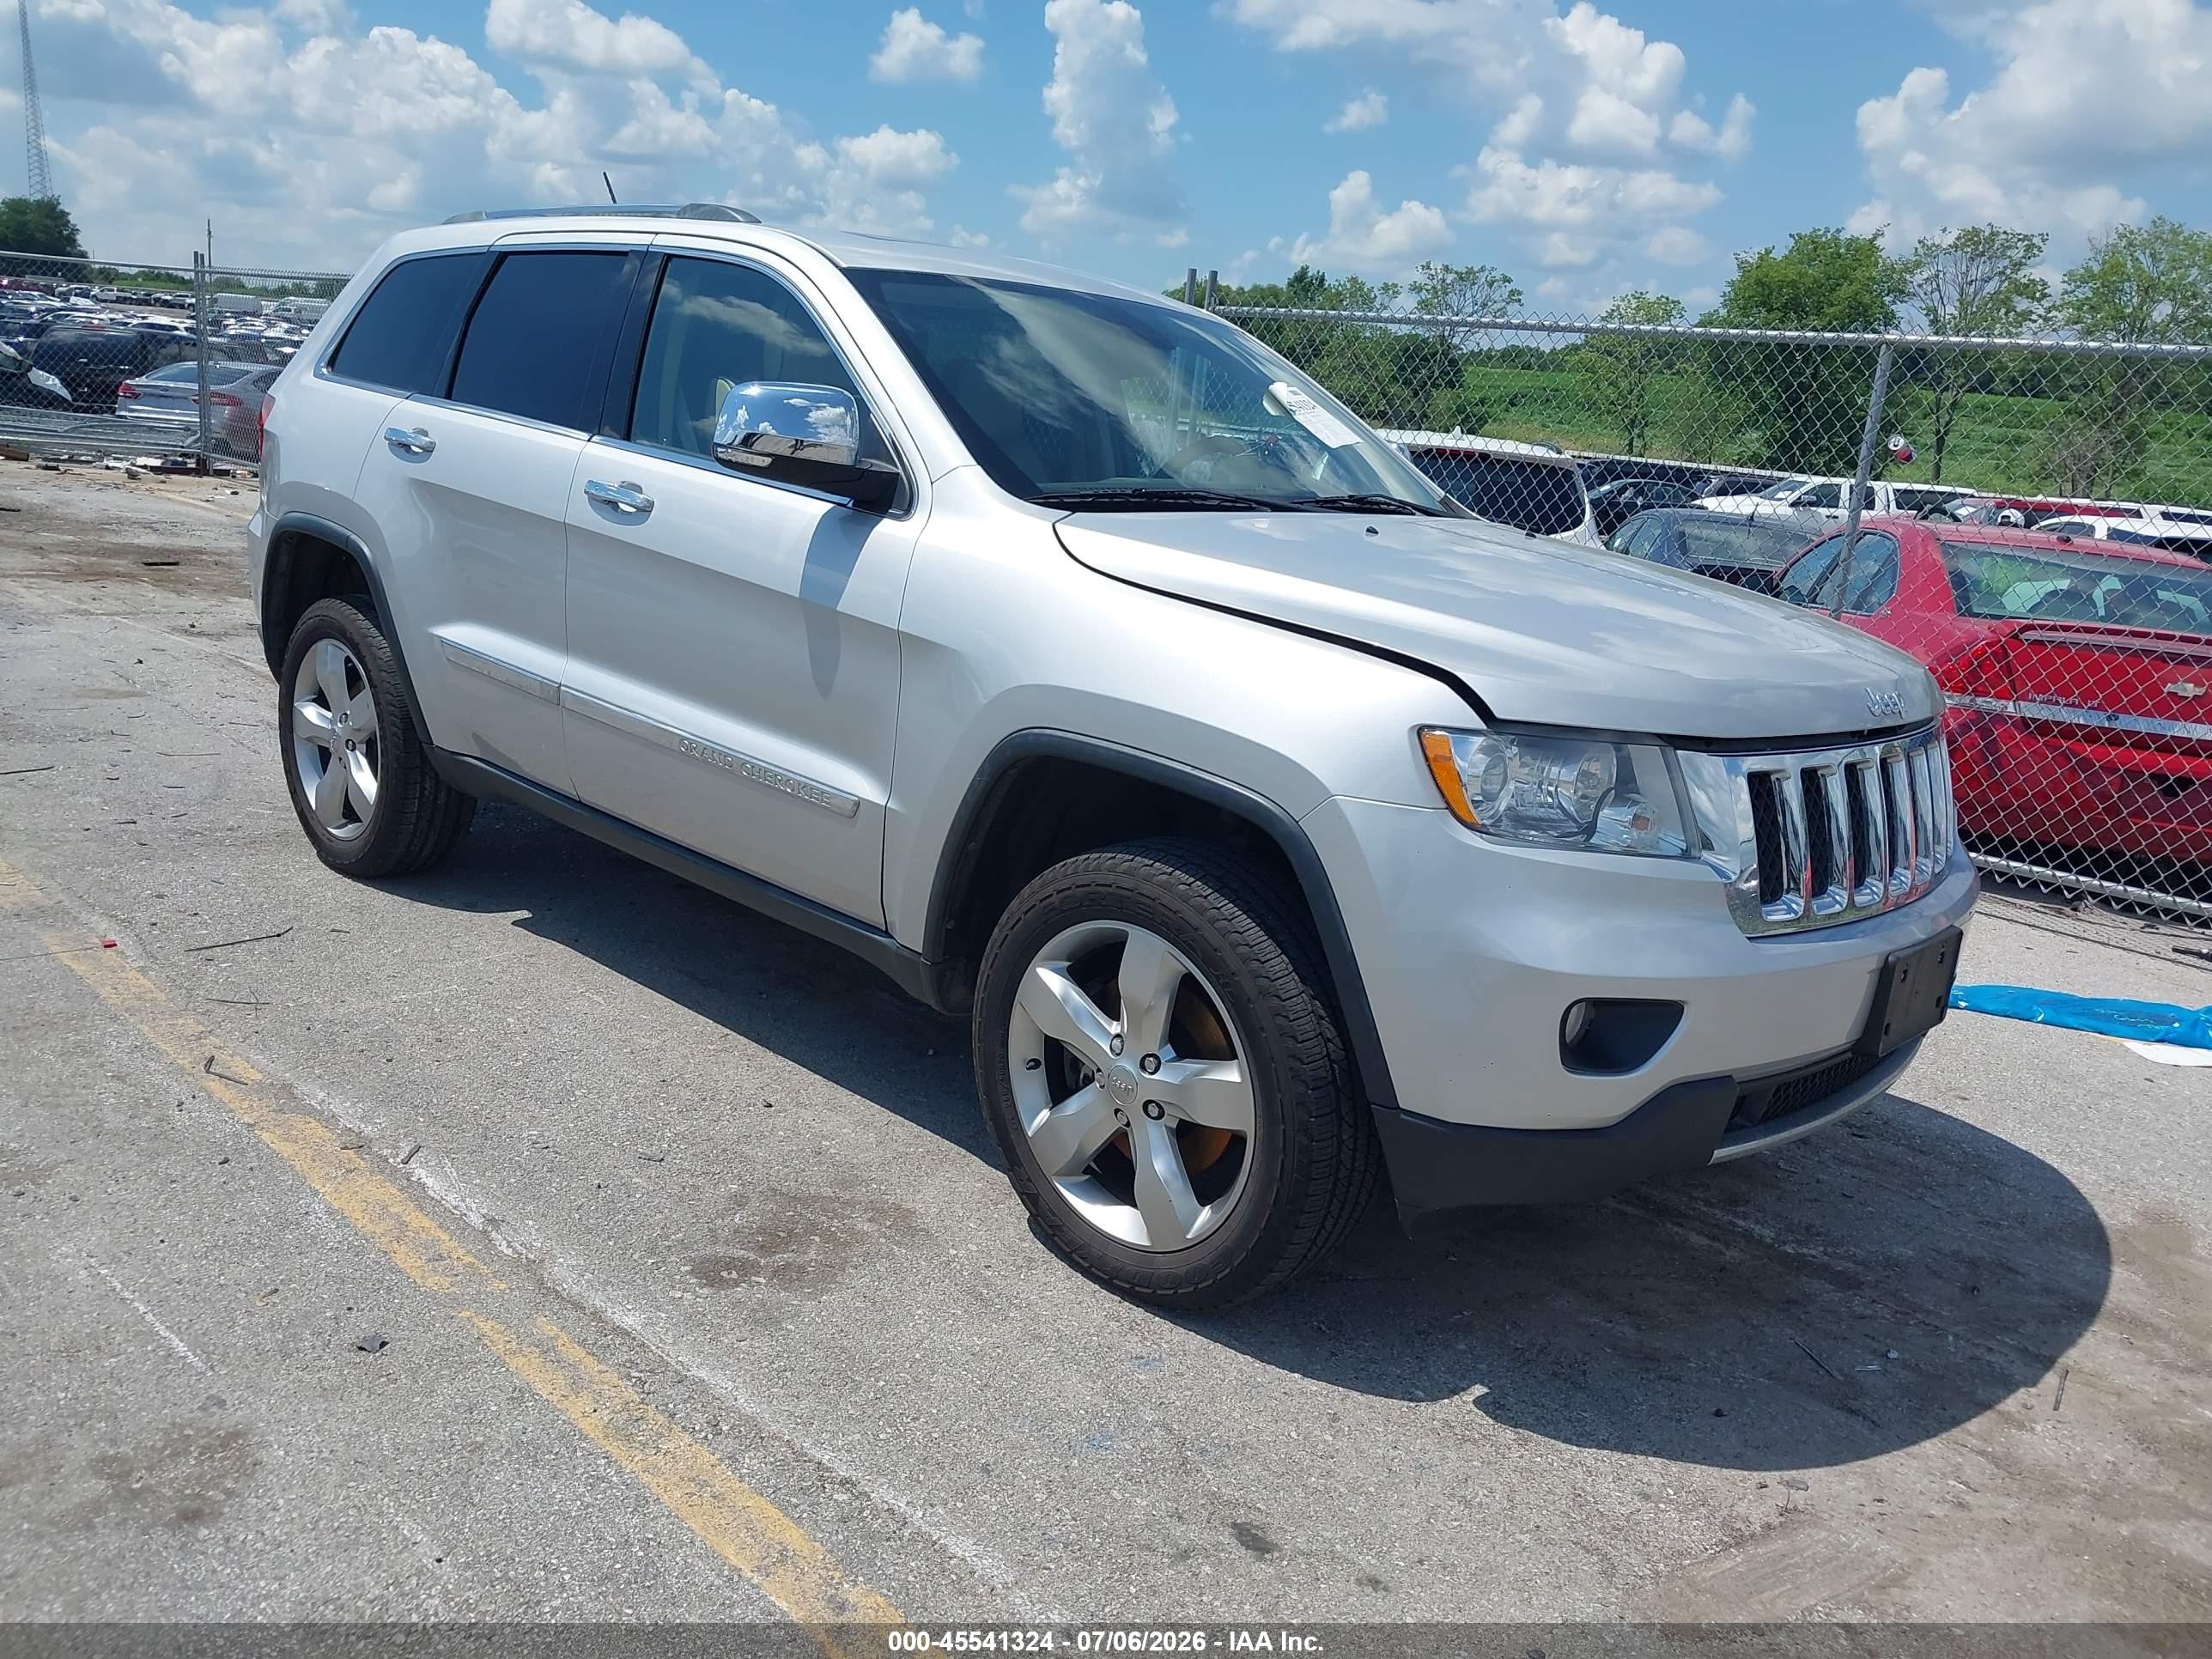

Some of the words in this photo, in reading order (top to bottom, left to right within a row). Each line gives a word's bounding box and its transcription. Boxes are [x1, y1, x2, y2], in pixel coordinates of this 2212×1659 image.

[1864, 686, 1905, 720] Jeep
[678, 738, 734, 769] GRAND
[740, 761, 832, 808] CHEROKEE
